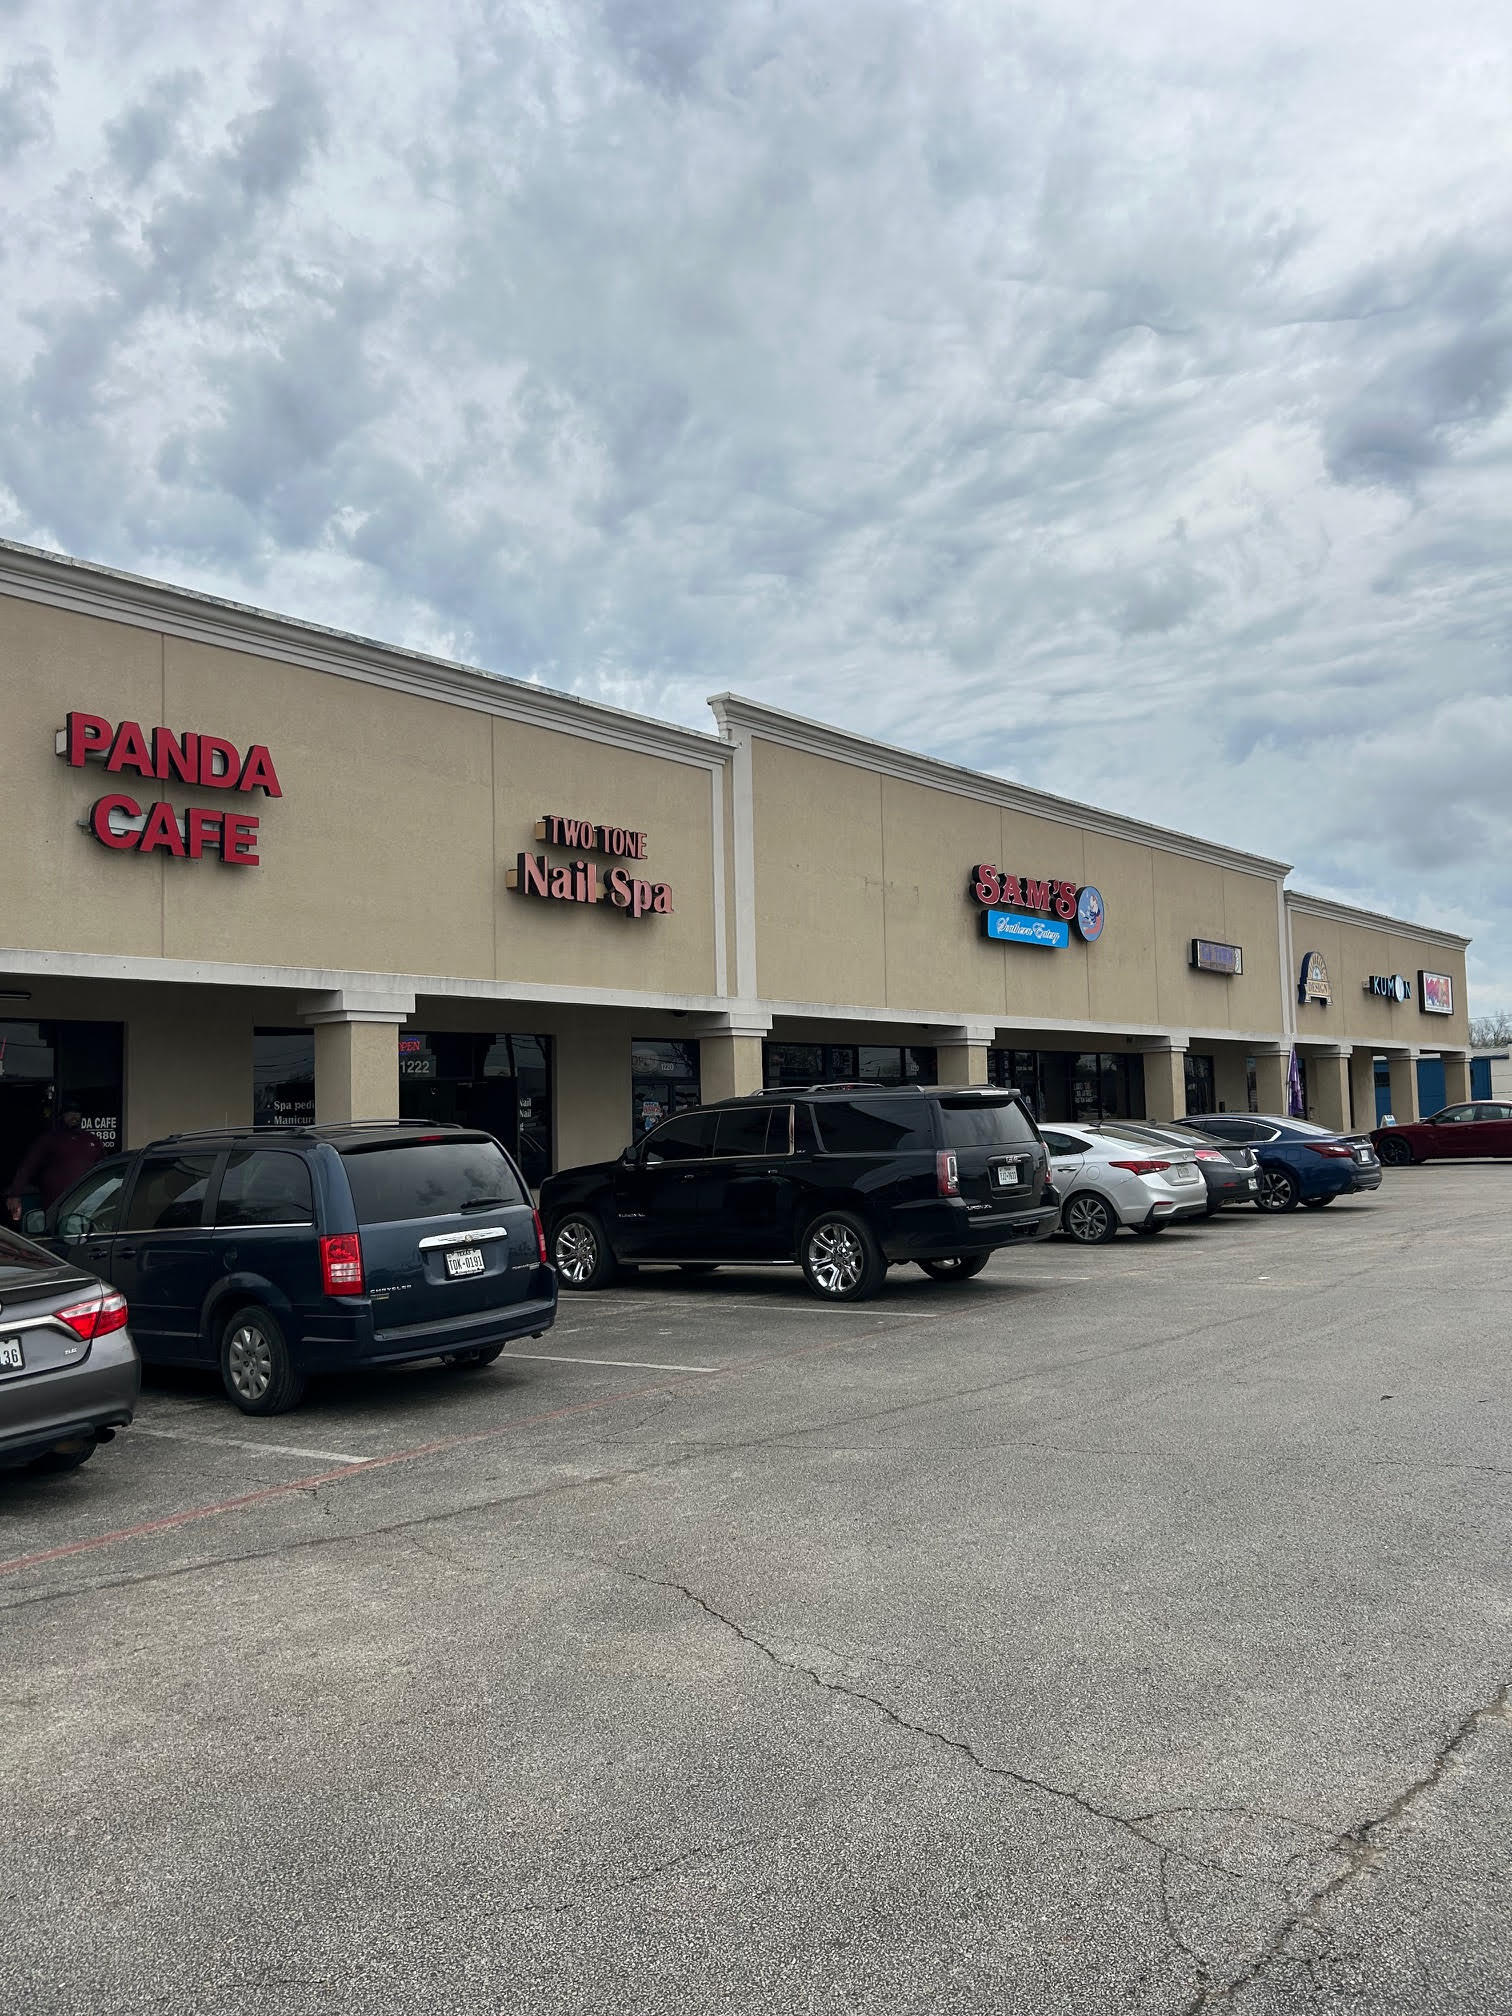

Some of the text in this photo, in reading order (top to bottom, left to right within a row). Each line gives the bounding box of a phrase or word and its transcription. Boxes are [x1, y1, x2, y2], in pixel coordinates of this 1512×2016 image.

[67, 711, 283, 798] PANDA
[91, 793, 260, 866] CAFE
[547, 815, 648, 859] TWO TONE
[519, 852, 674, 918] Nail Spa
[972, 863, 1077, 920] SAM'S
[400, 1060, 430, 1073] 1222
[94, 1117, 117, 1129] CAFE
[273, 1100, 291, 1112] Spa
[274, 1115, 315, 1125] Manicur
